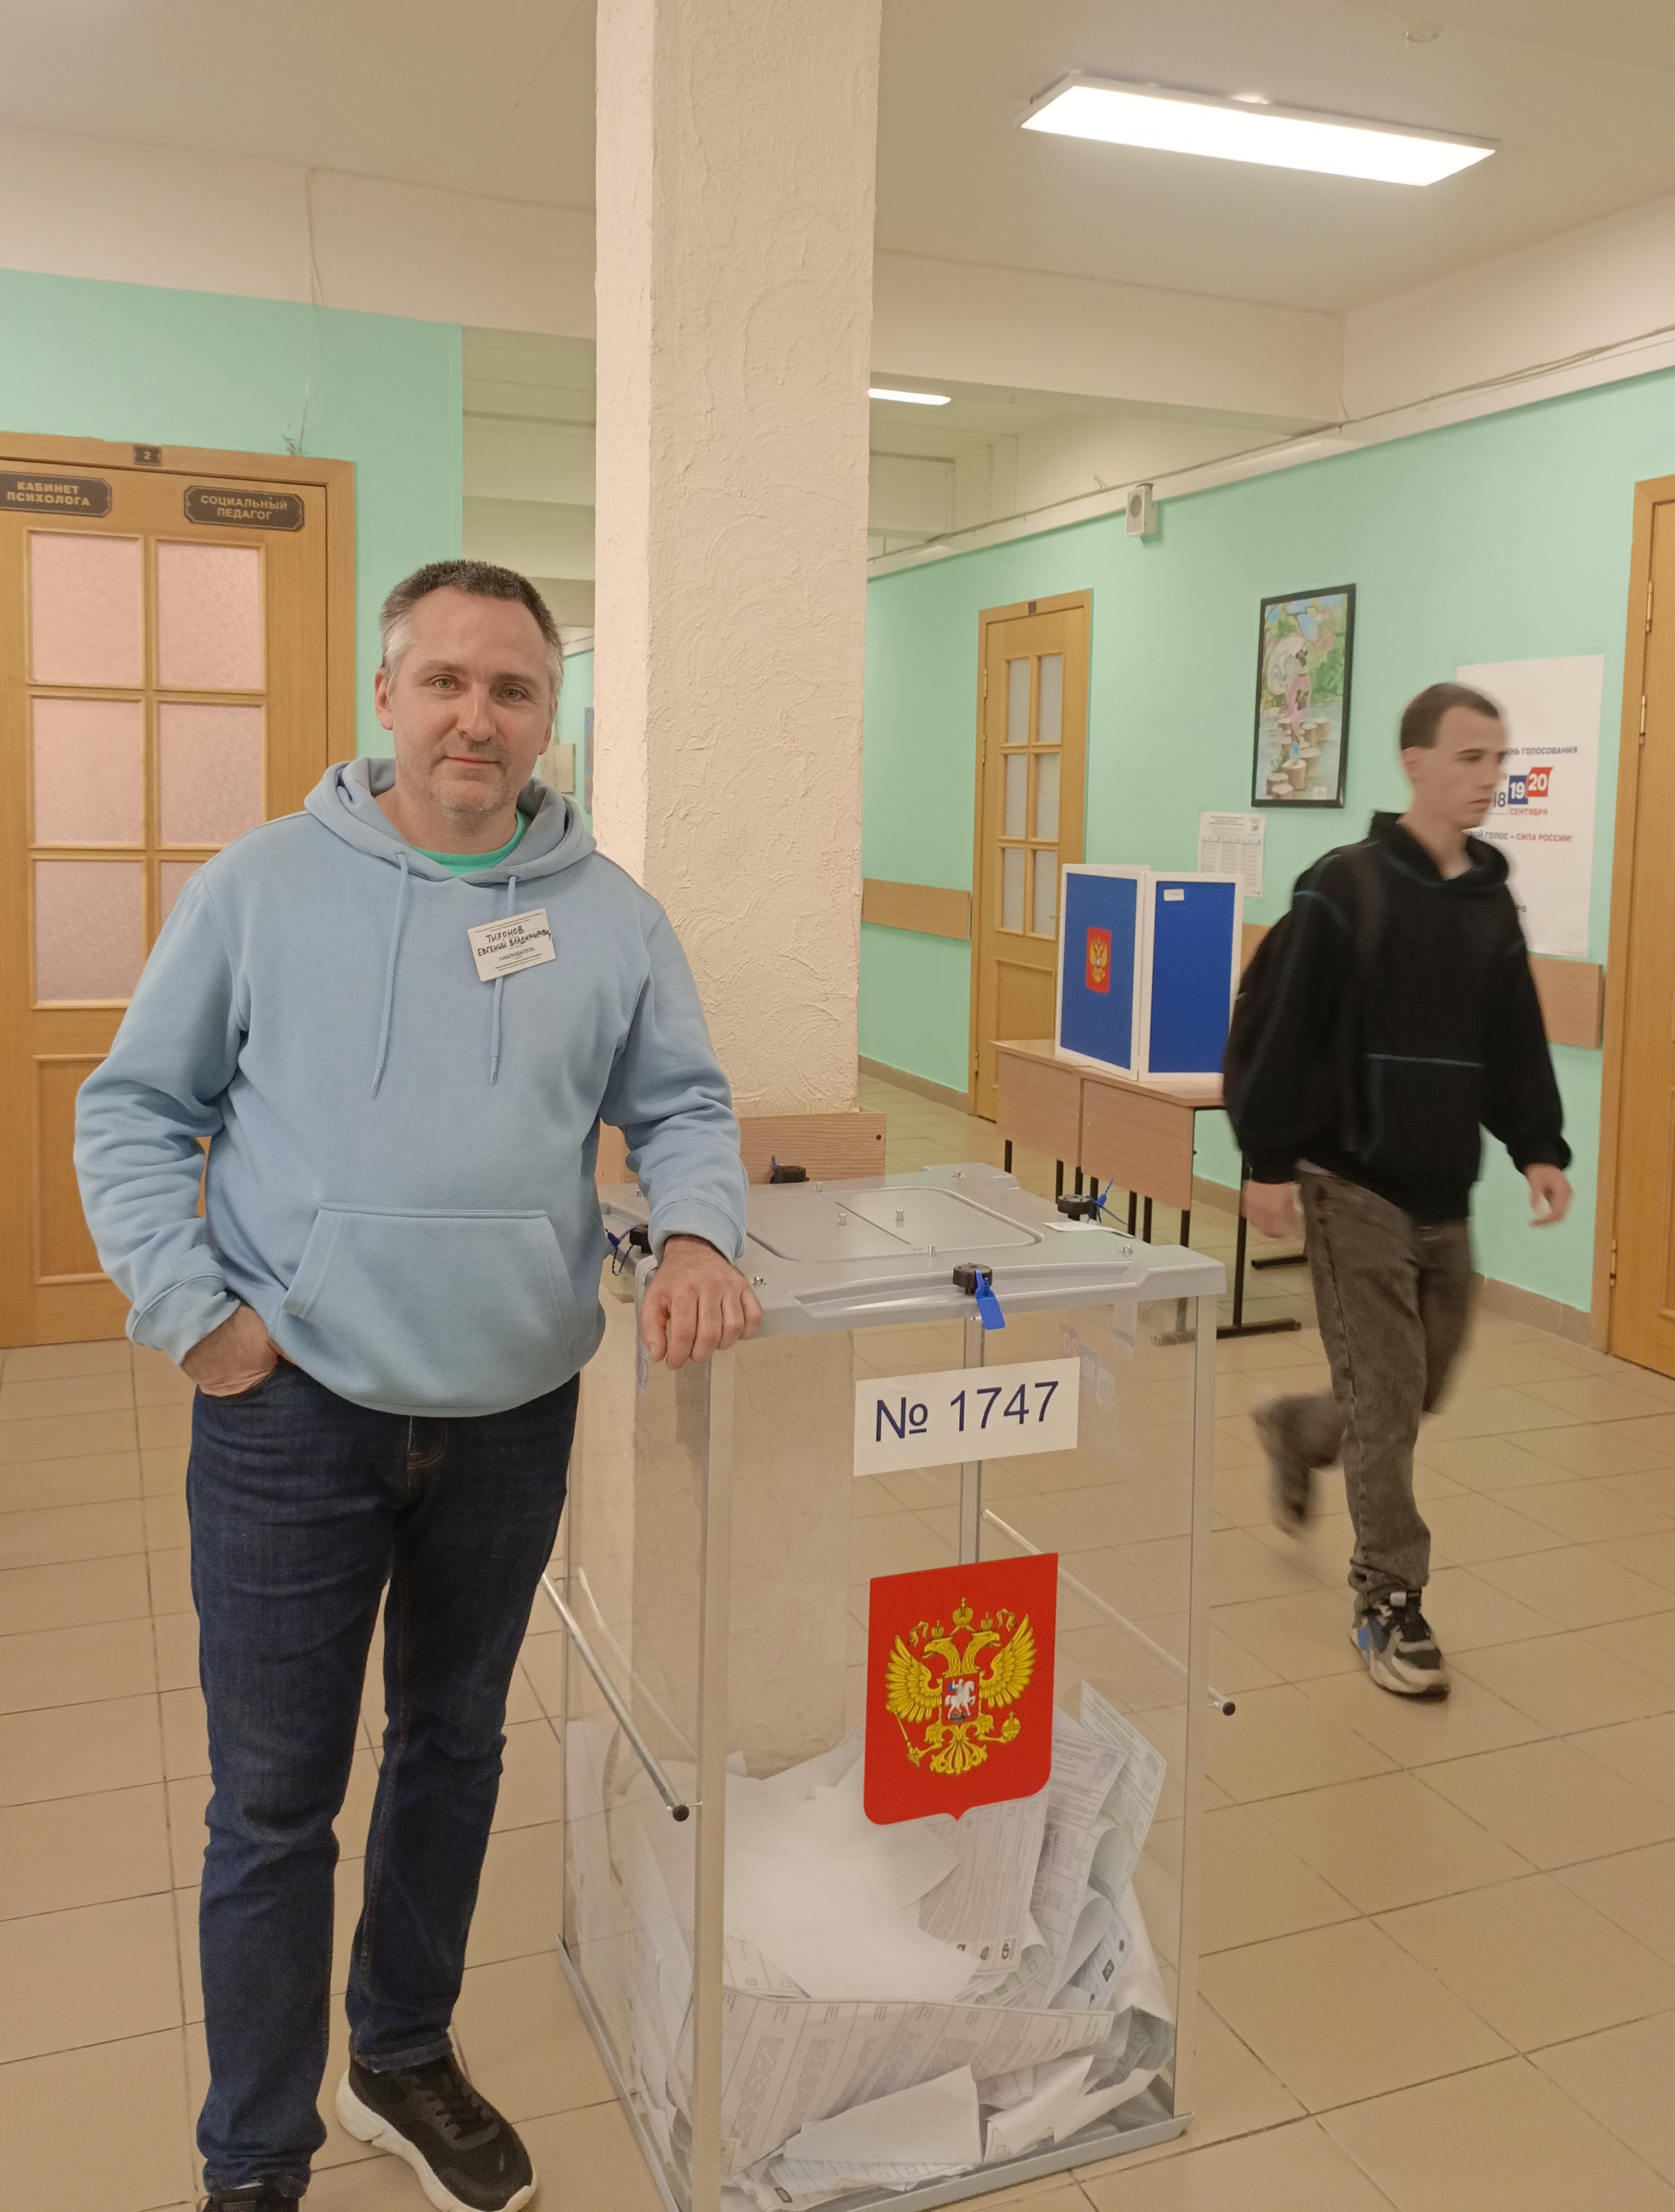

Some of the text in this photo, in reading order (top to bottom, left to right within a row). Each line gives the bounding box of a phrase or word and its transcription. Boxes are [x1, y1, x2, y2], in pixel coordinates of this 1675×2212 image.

[144, 451, 151, 460] 2
[17, 481, 79, 494] КАБИНЕТ
[7, 491, 89, 507] ПСИХОЛОГА
[201, 495, 287, 510] СОЦИАЛЬНЫЙ
[217, 508, 272, 520] ПЕДАГОГ
[1504, 746, 1577, 756] ЕНЬ ГОЛОСОВАНИЯ
[1493, 773, 1547, 808] 18 19 20
[1510, 808, 1548, 816] СЕНТЯБРЯ
[1485, 831, 1508, 840] ГОЛОС
[1516, 833, 1536, 841] СИЛА
[1538, 833, 1573, 843] РОССИИ!
[485, 926, 524, 943] ТИХОНОВ
[499, 947, 535, 961] НАБЛЮДАТЕЛЬ
[876, 1380, 1059, 1442] № 1747
